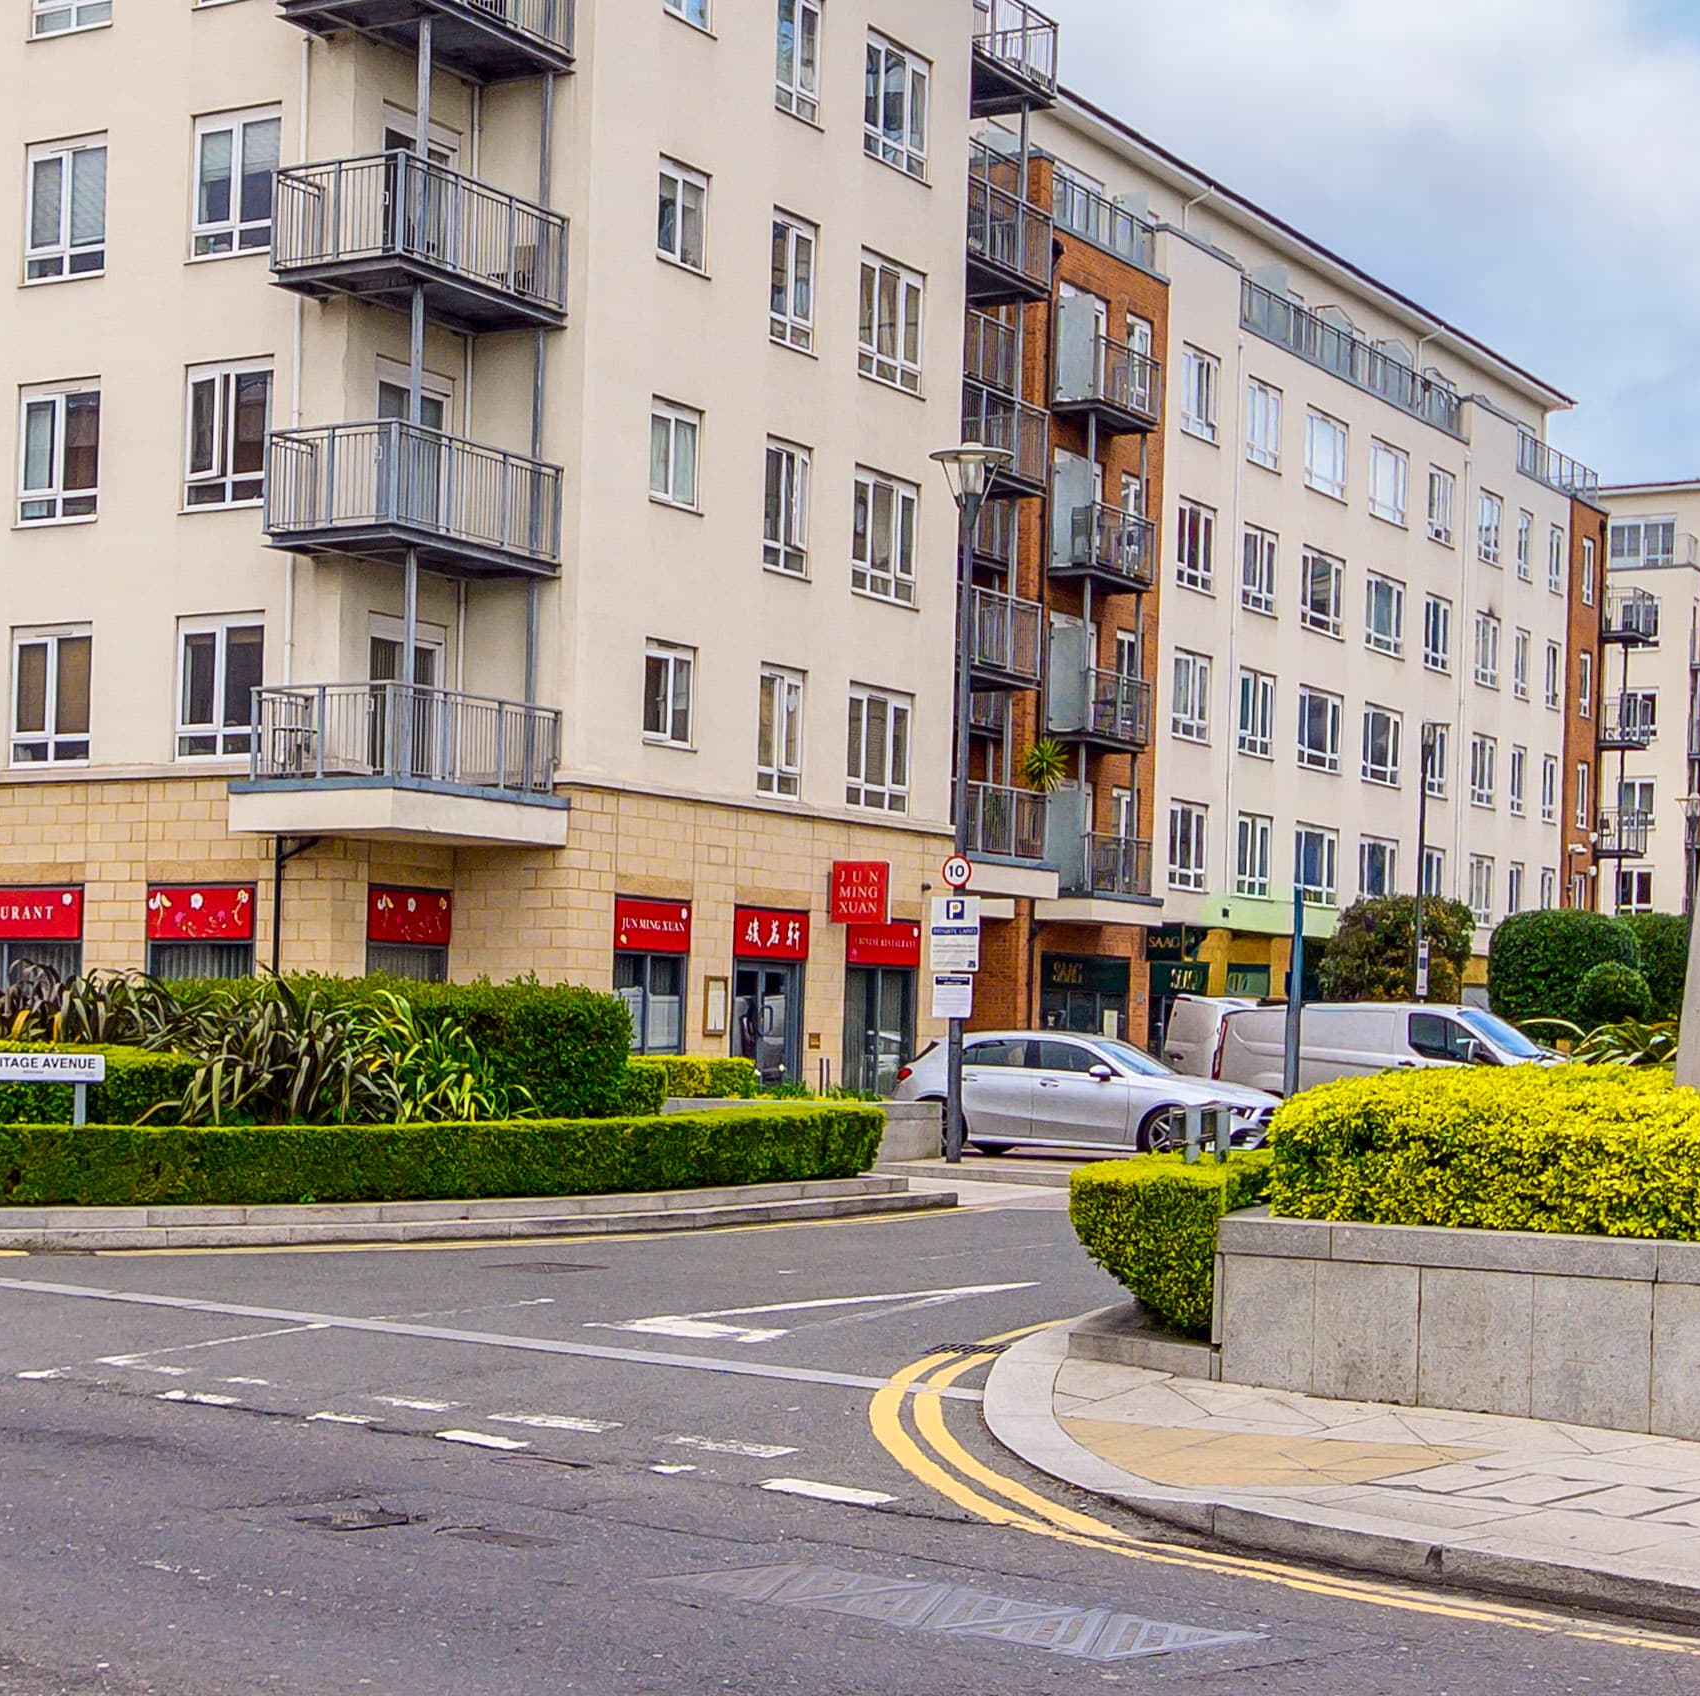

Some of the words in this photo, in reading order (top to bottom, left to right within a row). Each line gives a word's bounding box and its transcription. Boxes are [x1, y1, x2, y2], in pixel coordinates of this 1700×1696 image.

[839, 870, 879, 883] JUN
[948, 865, 964, 877] 10
[838, 886, 878, 898] MING
[838, 901, 877, 914] XUAN
[949, 901, 962, 919] P
[621, 916, 638, 931] JUN
[639, 917, 661, 931] MING
[662, 920, 686, 933] XUAN
[42, 1058, 96, 1069] AVENUE
